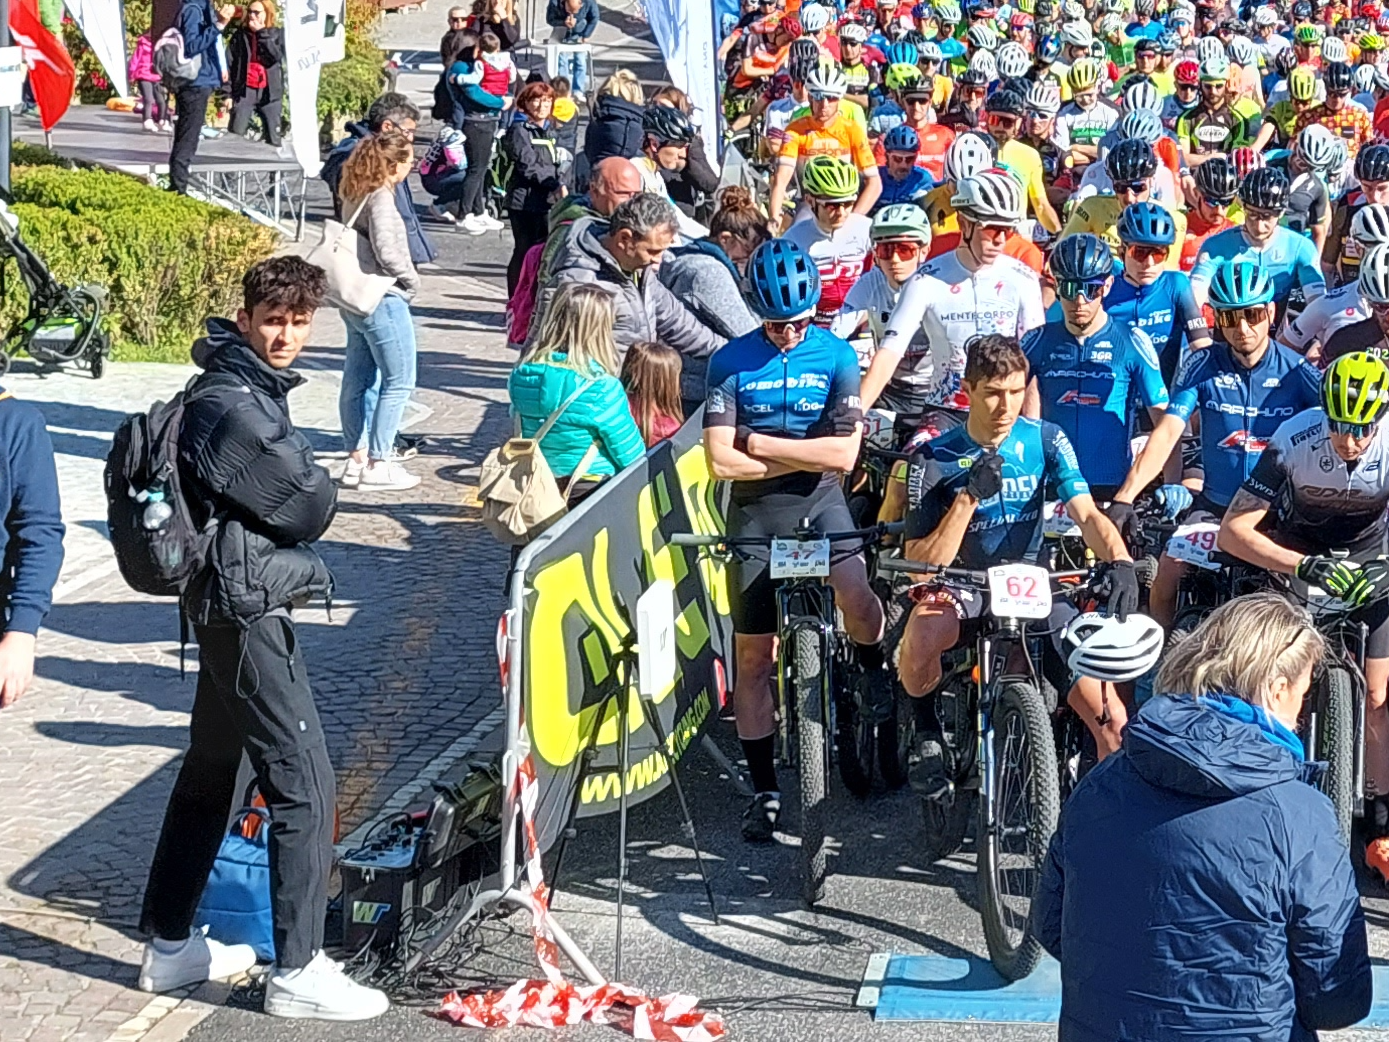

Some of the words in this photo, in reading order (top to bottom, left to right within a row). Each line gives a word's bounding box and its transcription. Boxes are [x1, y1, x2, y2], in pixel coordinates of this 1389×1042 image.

[940, 310, 1015, 321] MENTECORPO
[1185, 531, 1216, 551] 49
[1006, 576, 1038, 598] 62
